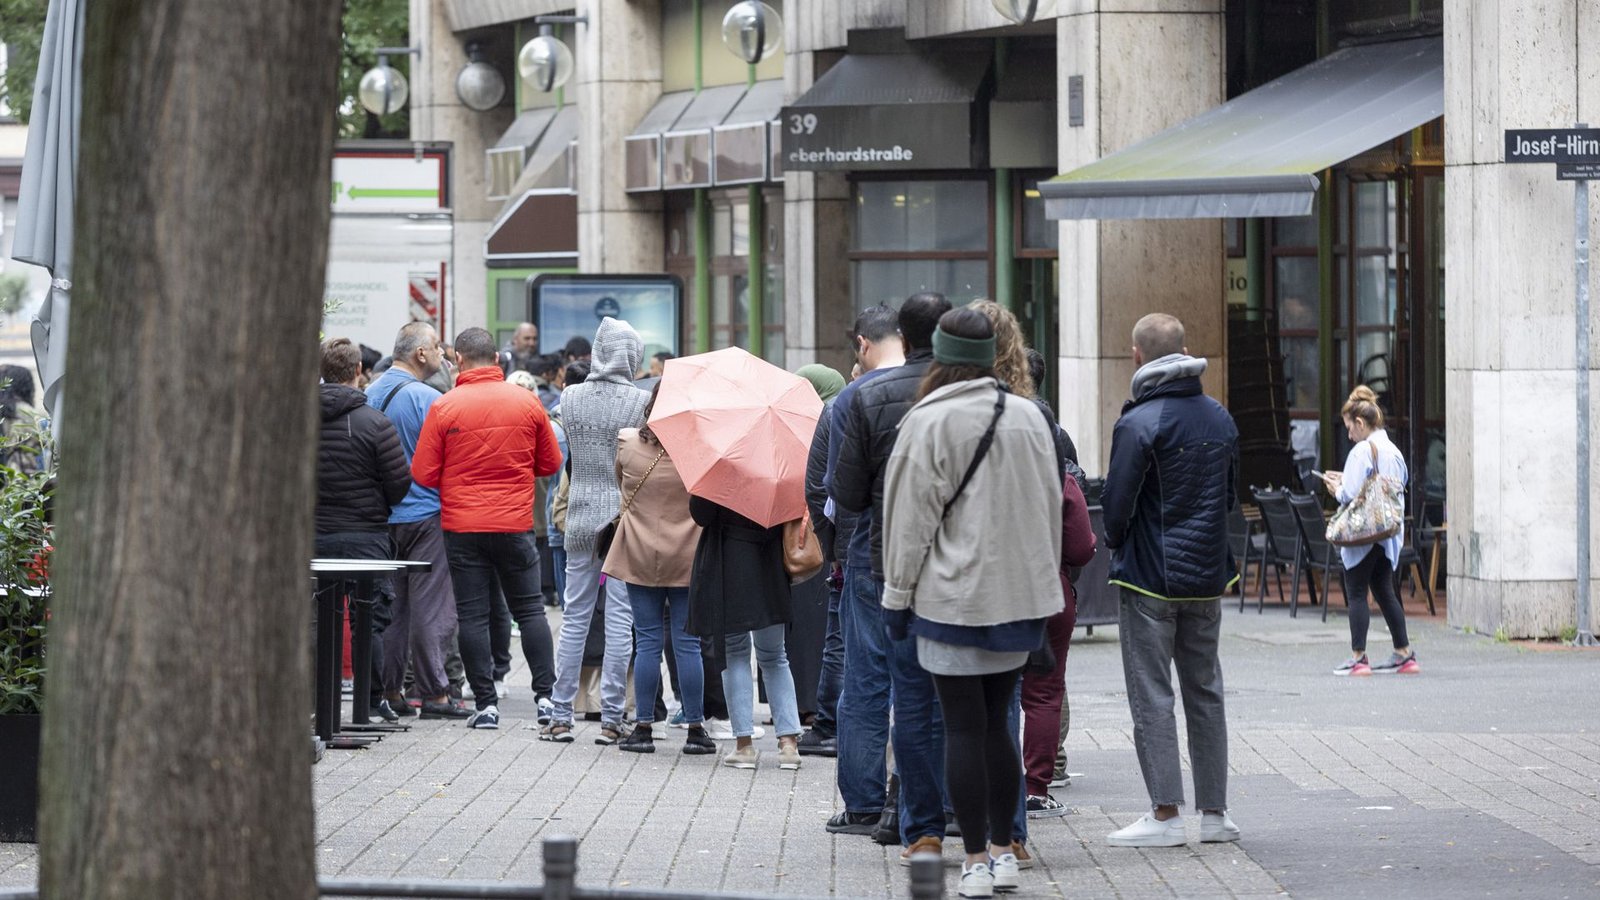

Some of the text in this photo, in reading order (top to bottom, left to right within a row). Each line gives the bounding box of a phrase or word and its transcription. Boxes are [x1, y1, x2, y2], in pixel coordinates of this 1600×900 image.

[790, 113, 817, 134] 39
[789, 145, 913, 161] eberhardstraße
[1512, 135, 1600, 155] Josef-Hirn
[326, 282, 388, 291] OSSHANDEL
[1227, 271, 1247, 291] io
